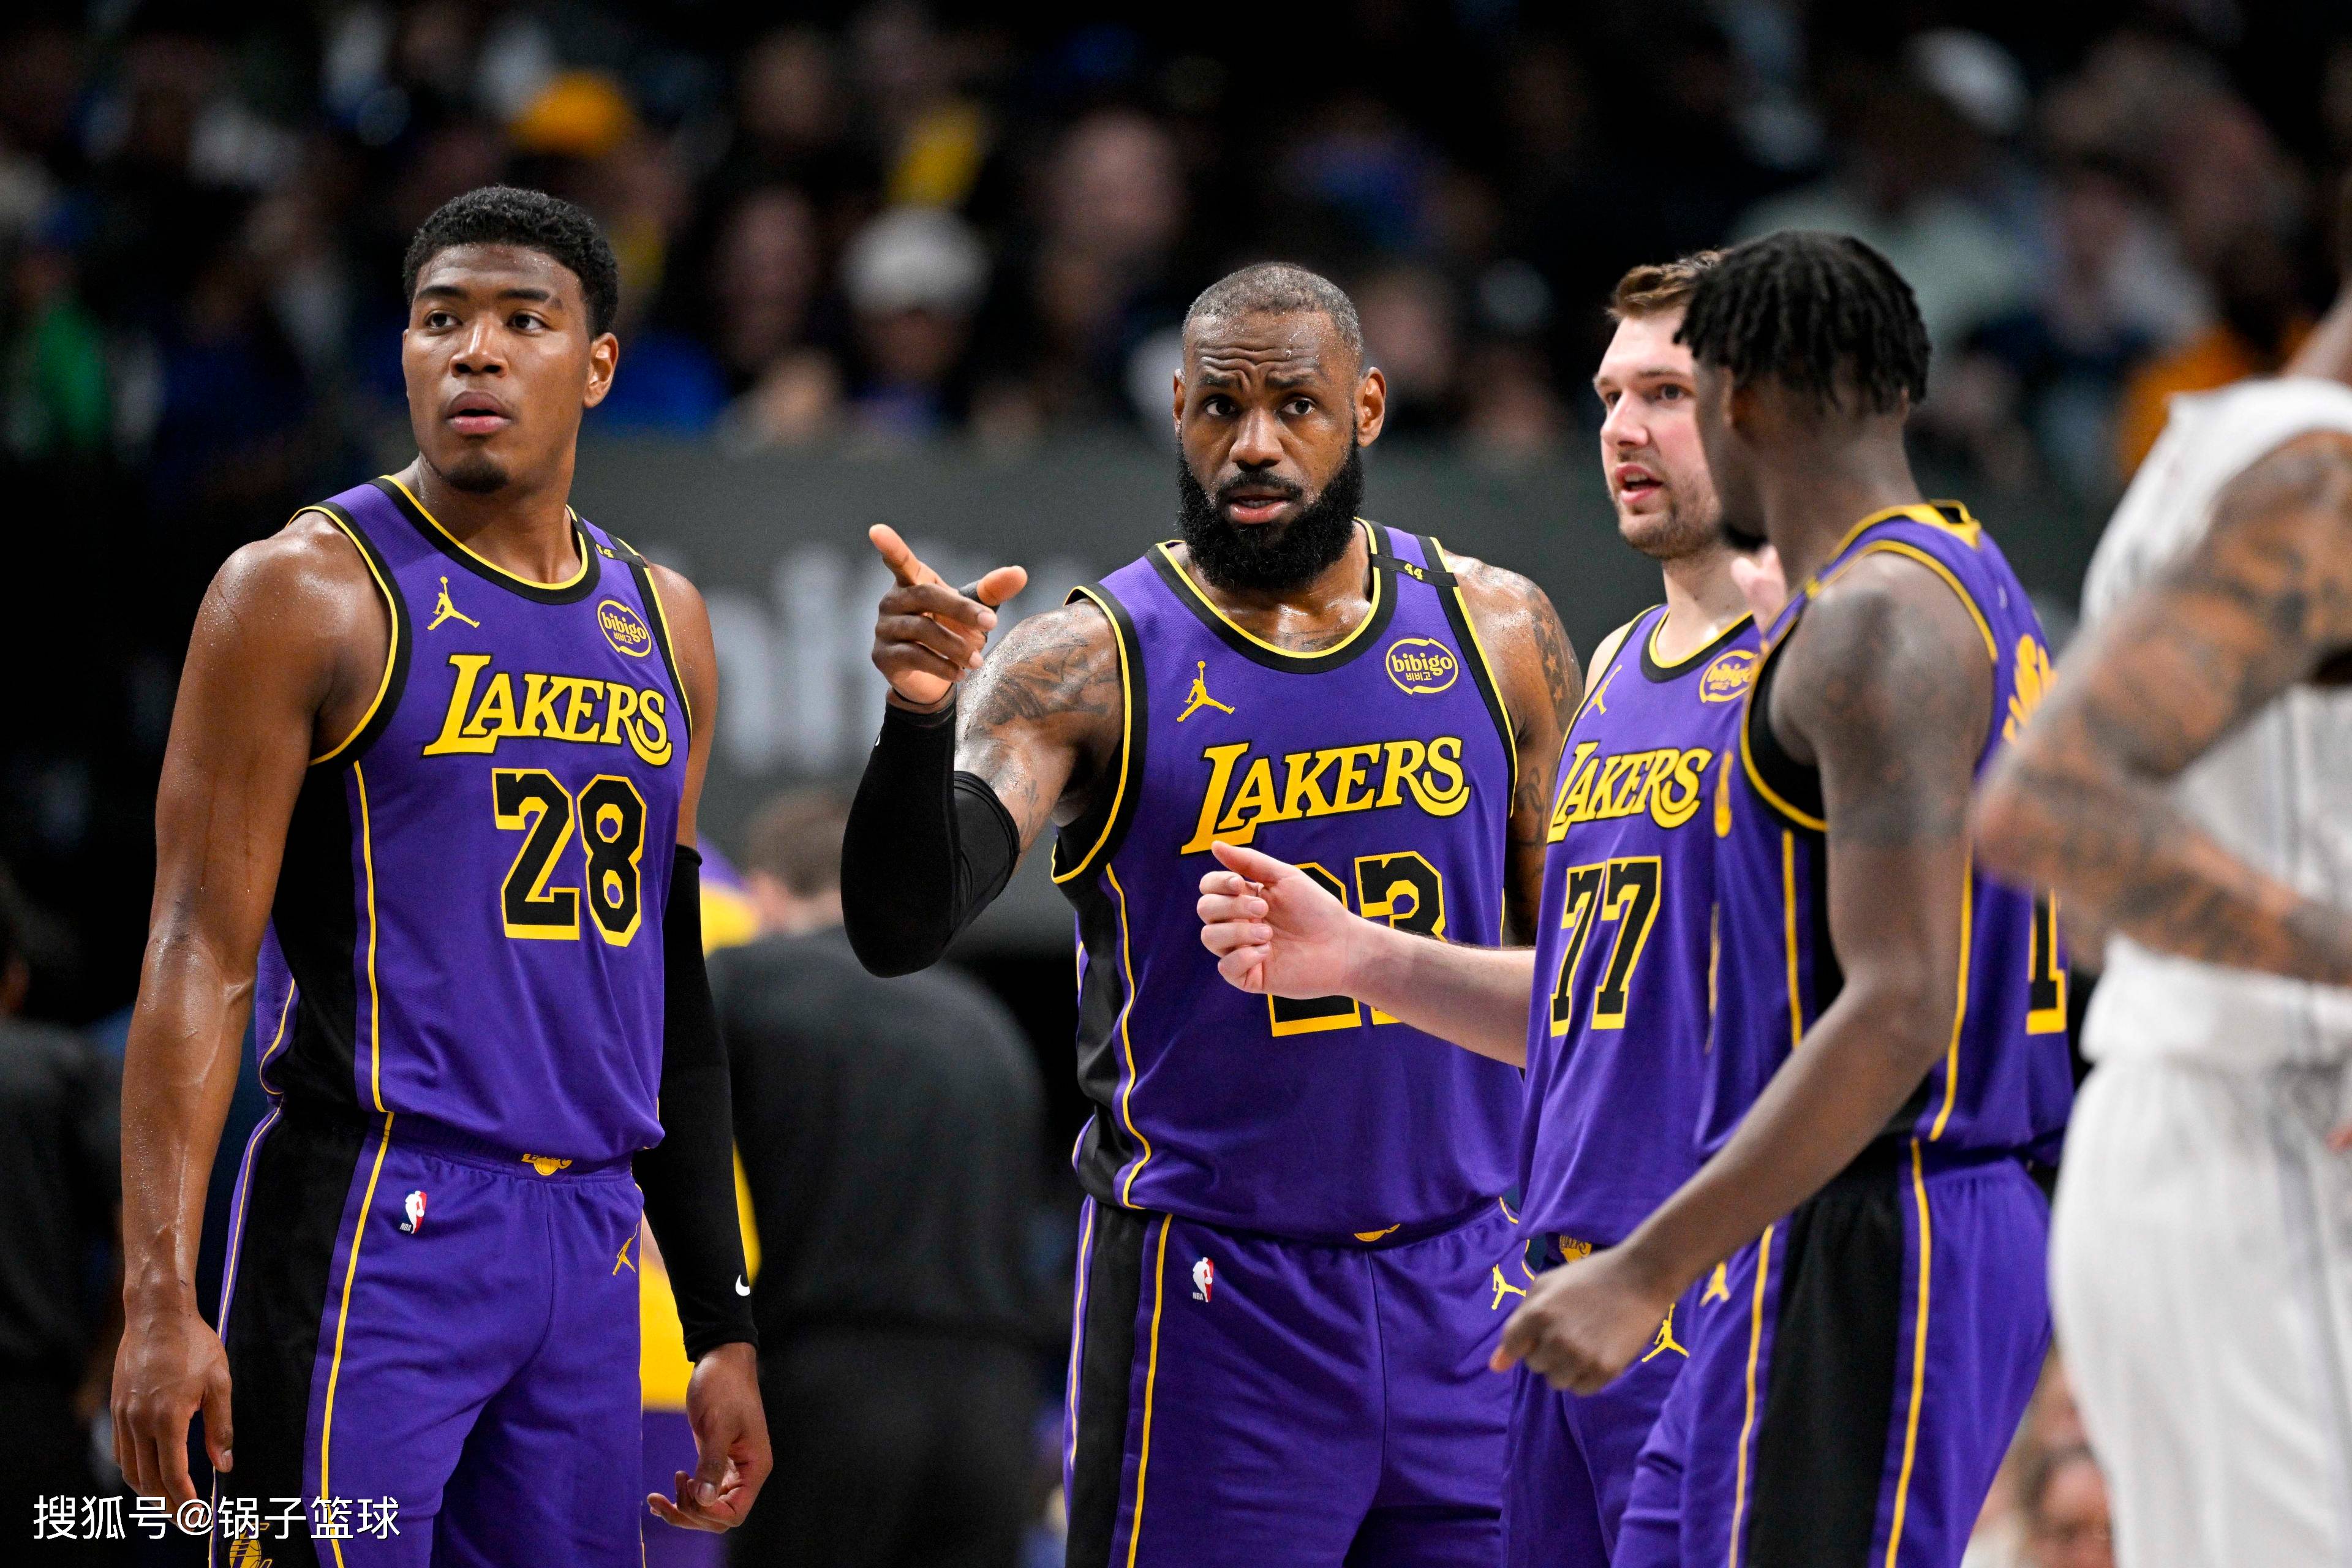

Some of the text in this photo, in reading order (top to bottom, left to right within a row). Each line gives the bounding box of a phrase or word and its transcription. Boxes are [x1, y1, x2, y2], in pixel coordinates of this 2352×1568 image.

[1404, 563, 1423, 580] 44
[601, 612, 647, 643] bibigo
[1392, 652, 1453, 676] bibigo
[1406, 671, 1432, 682] 비비고
[422, 654, 672, 767] LAKERS
[1180, 736, 1470, 855] LAKERS
[1547, 739, 1713, 843] LAKERS
[492, 767, 647, 948] 28
[1550, 856, 1660, 1038] 77
[399, 1223, 412, 1232] NBA
[1193, 1292, 1204, 1300] NBA
